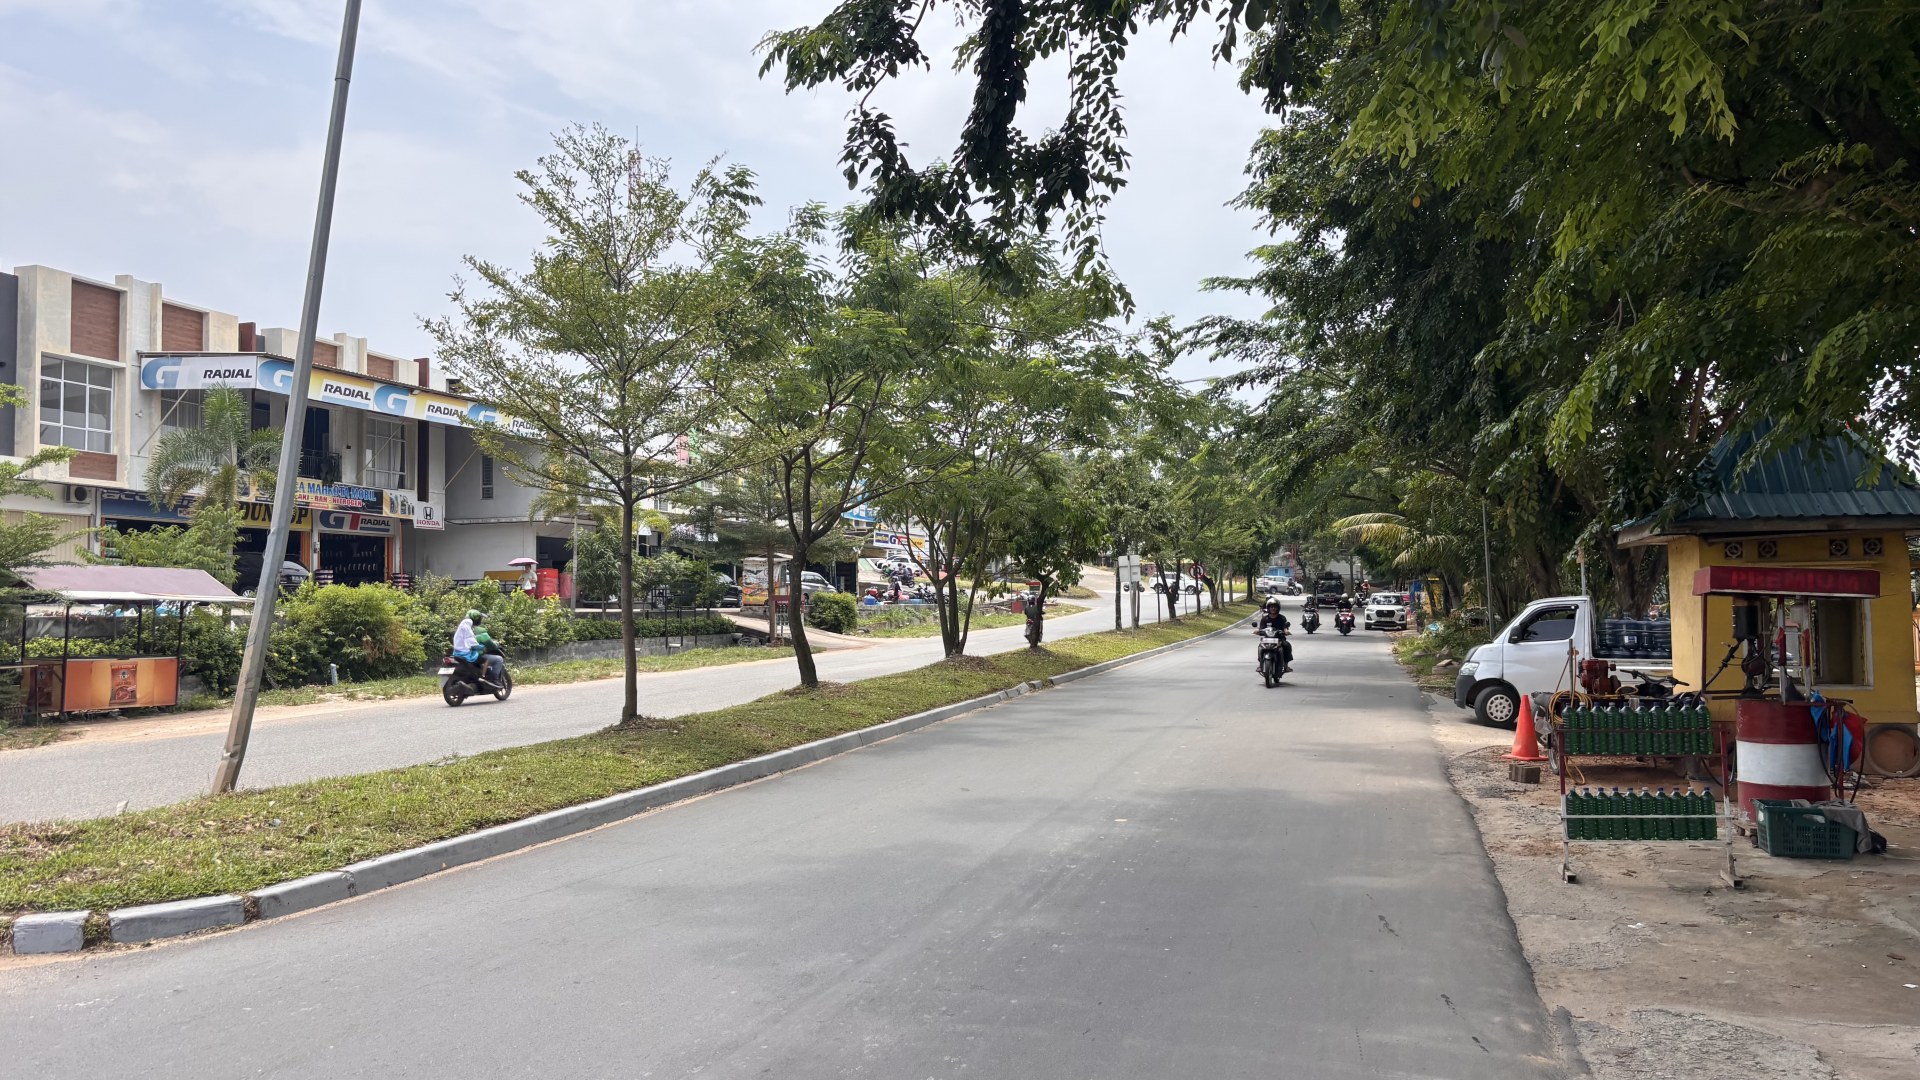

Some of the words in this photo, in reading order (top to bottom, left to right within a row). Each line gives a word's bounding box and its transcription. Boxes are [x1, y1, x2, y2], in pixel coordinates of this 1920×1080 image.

[203, 368, 252, 379] RADIAL
[323, 382, 371, 401] RADIAL
[351, 487, 376, 501] MOBIL
[360, 518, 391, 526] RADIAL
[416, 519, 440, 527] HONDA
[1731, 570, 1859, 592] PREMIUM
